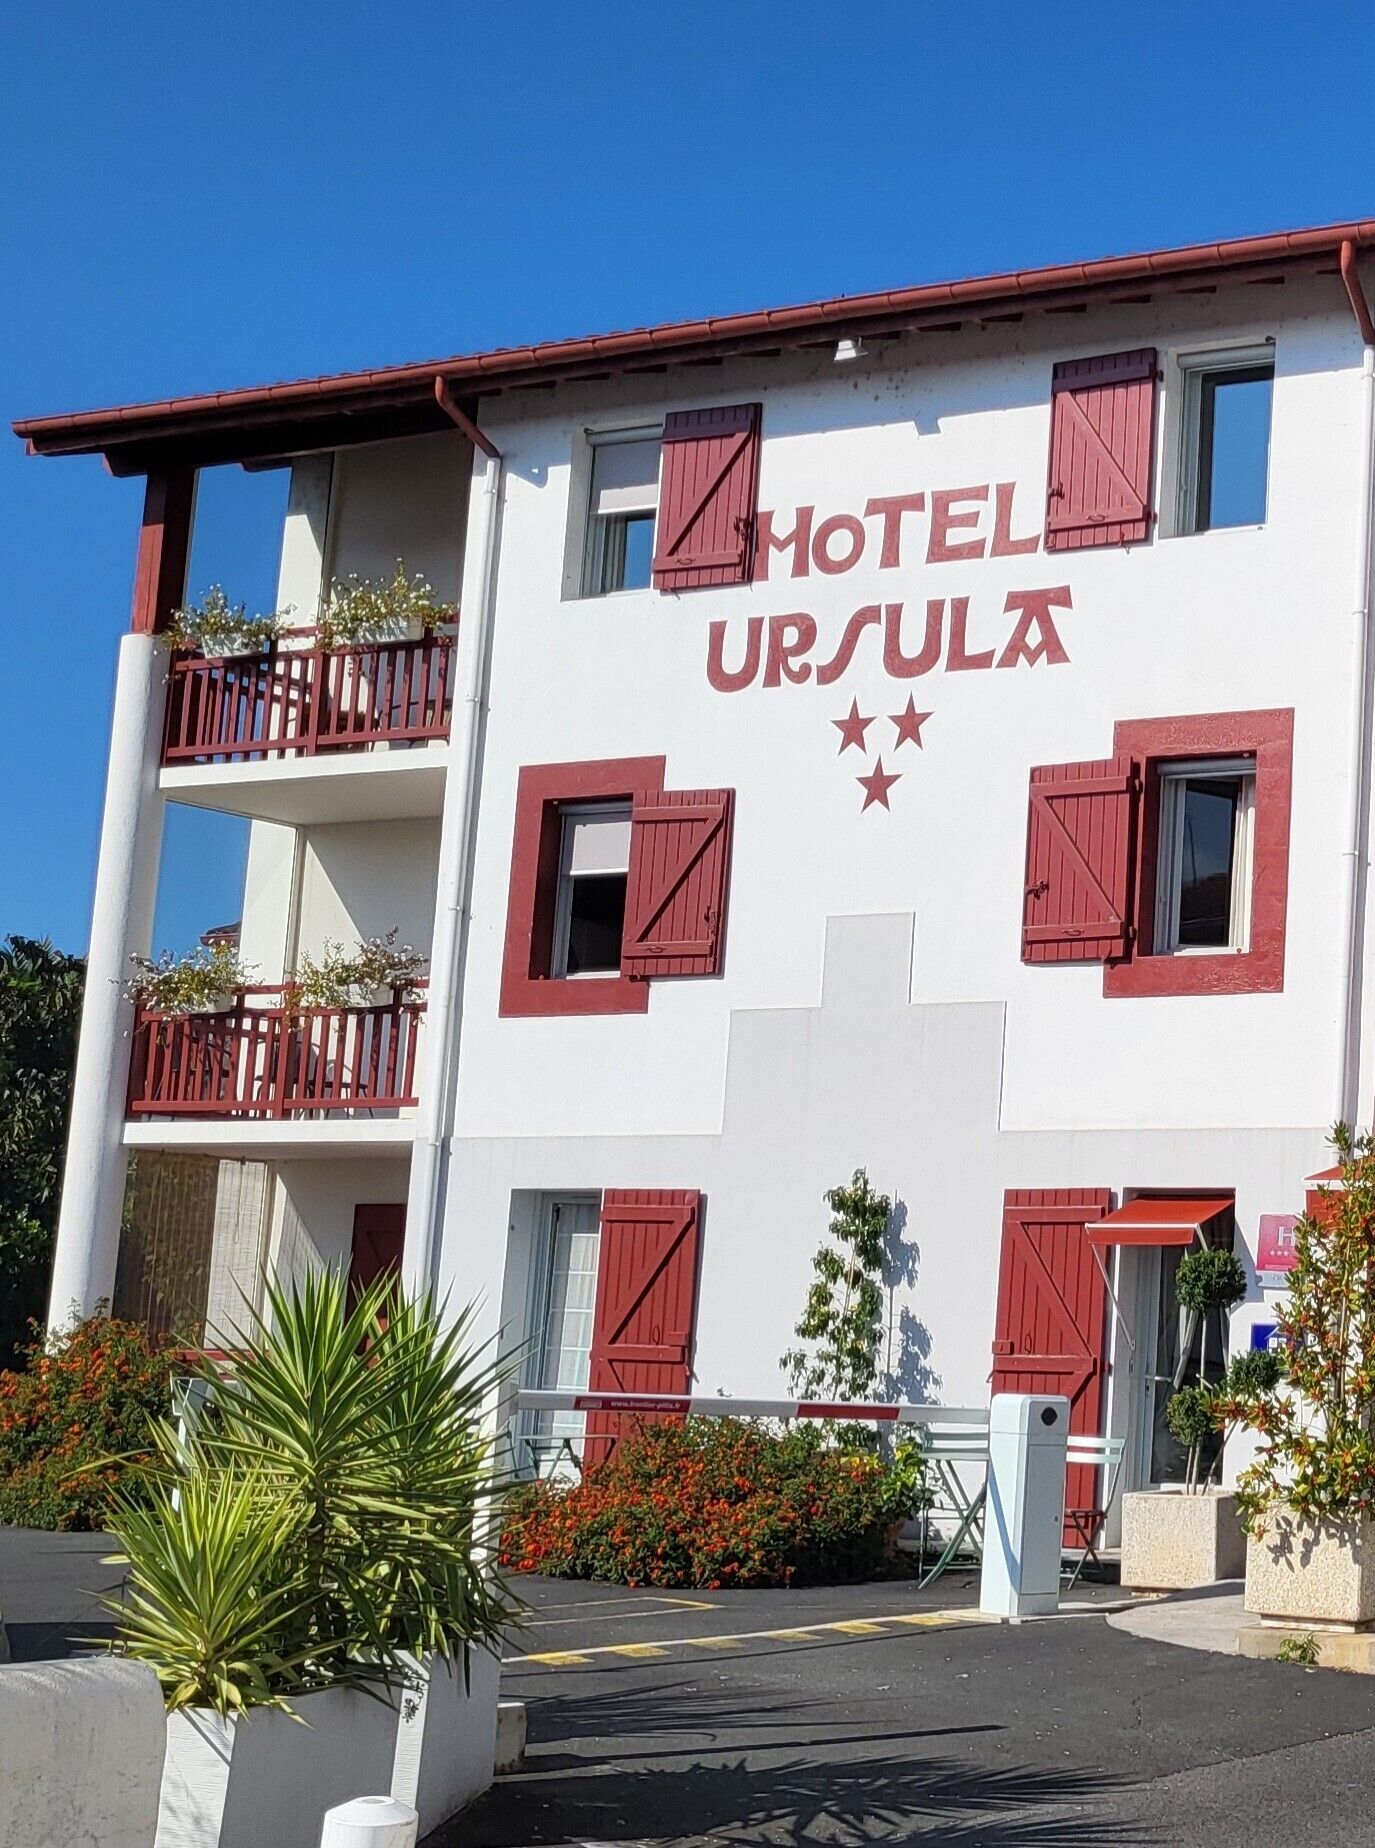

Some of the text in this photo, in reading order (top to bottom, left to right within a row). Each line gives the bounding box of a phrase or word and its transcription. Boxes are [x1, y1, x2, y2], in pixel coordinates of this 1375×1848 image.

[752, 481, 1041, 582] HOTEL
[706, 584, 1074, 693] URSULA
[1277, 1226, 1296, 1247] H
